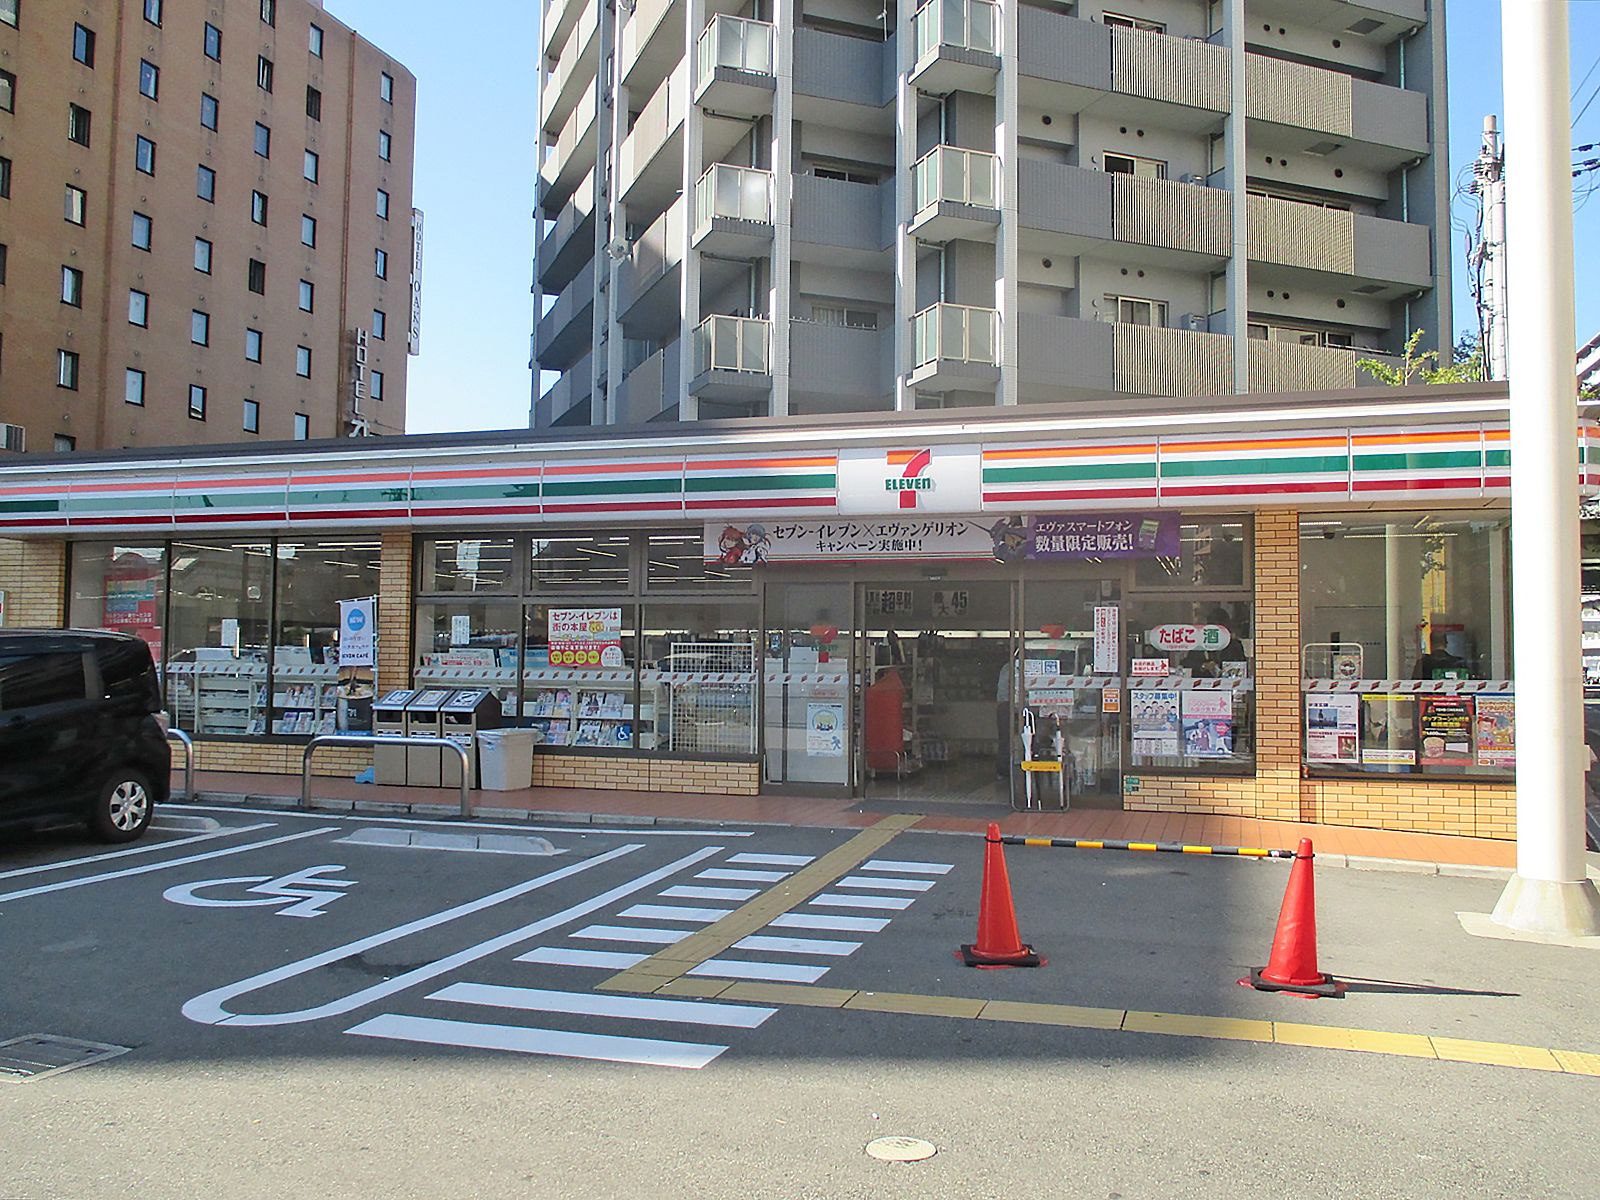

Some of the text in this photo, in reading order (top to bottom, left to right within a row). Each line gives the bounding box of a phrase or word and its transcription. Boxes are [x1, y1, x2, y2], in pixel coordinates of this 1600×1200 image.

[412, 281, 421, 340] OAKS
[354, 327, 369, 415] HOTEL
[886, 448, 931, 508] 7
[816, 539, 922, 552] キャンペーン実施中!
[1159, 628, 1196, 644] たばこ
[1203, 628, 1219, 644] 酒
